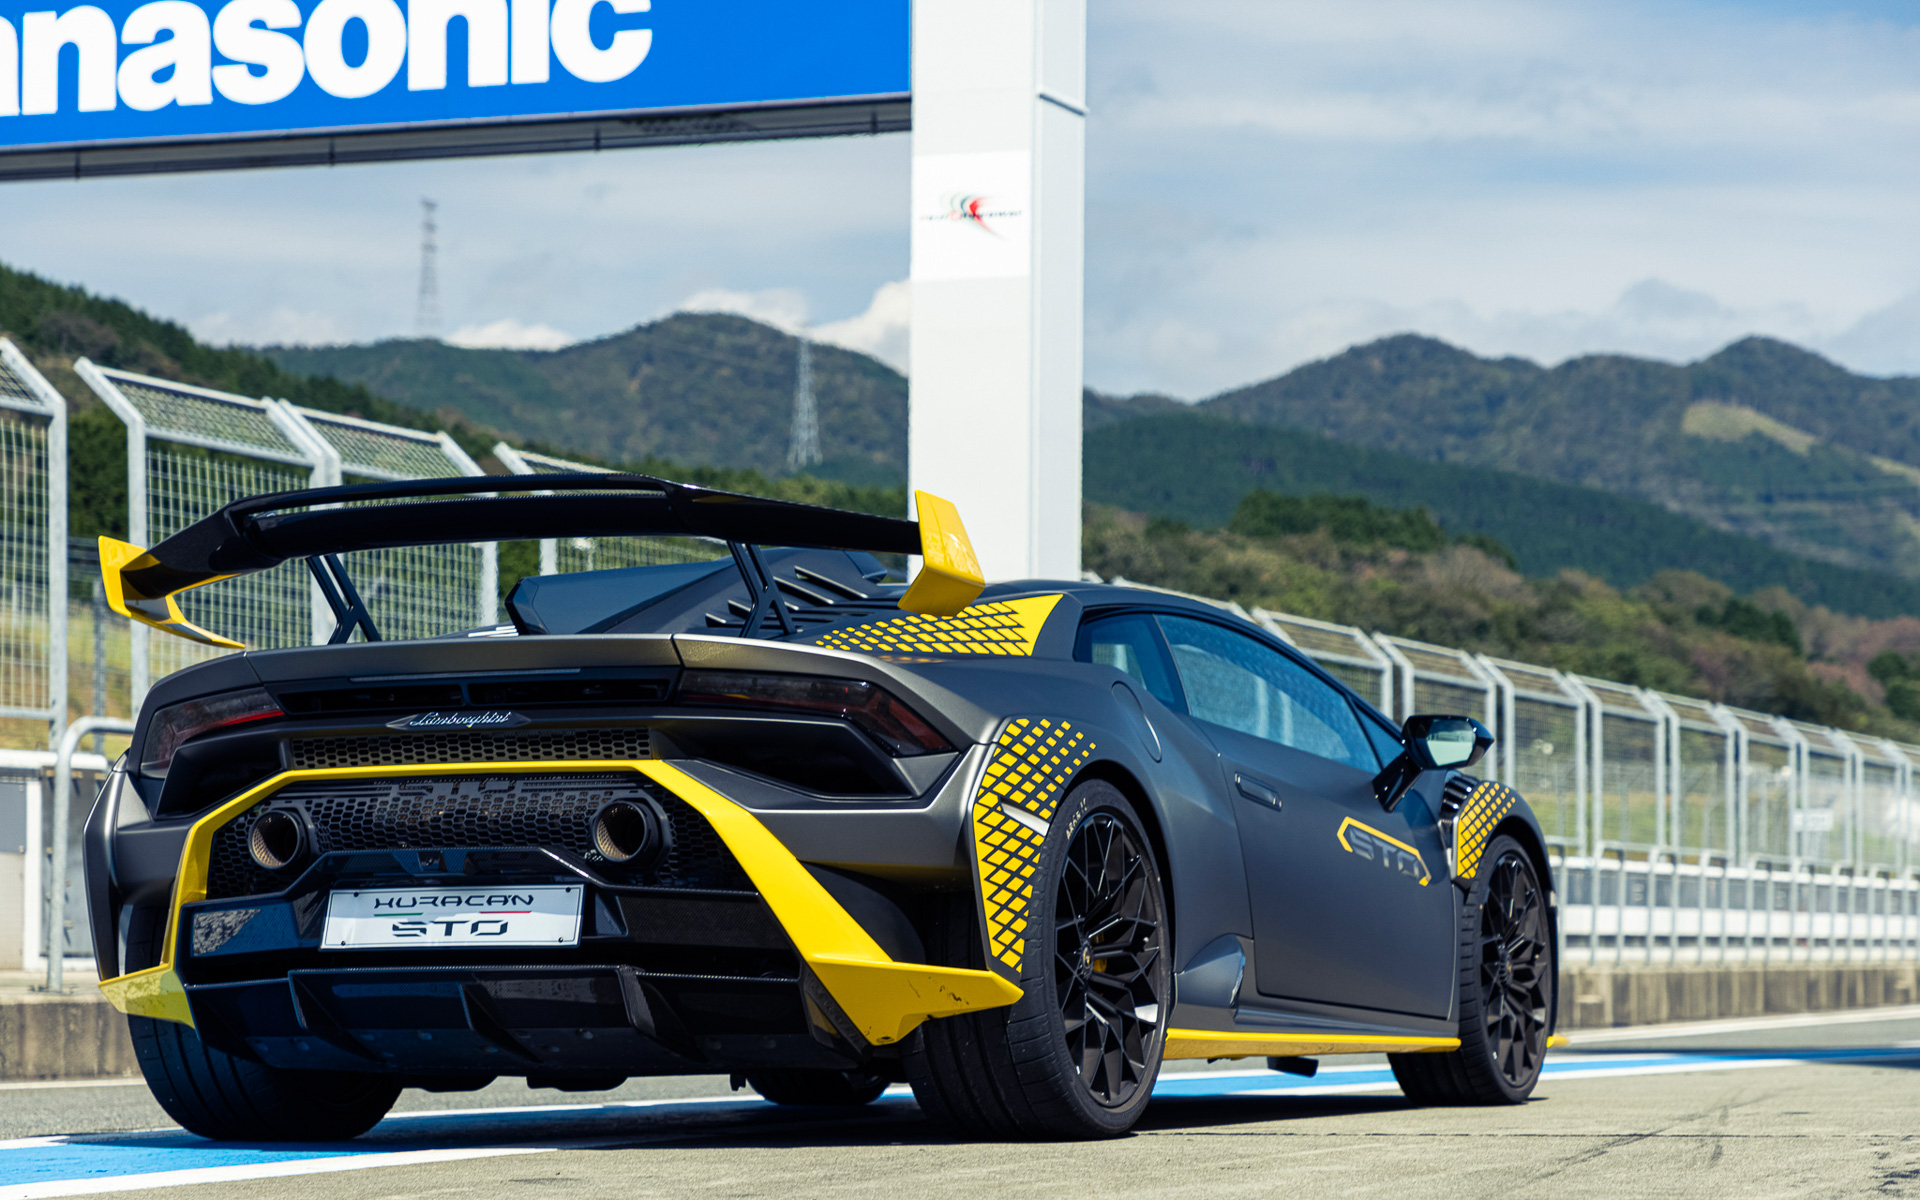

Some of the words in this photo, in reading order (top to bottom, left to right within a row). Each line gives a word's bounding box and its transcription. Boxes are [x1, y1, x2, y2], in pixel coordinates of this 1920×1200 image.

[0, 0, 652, 117] nasonic
[410, 711, 511, 728] Lamborghini
[1349, 829, 1420, 879] STO
[392, 920, 508, 937] STO
